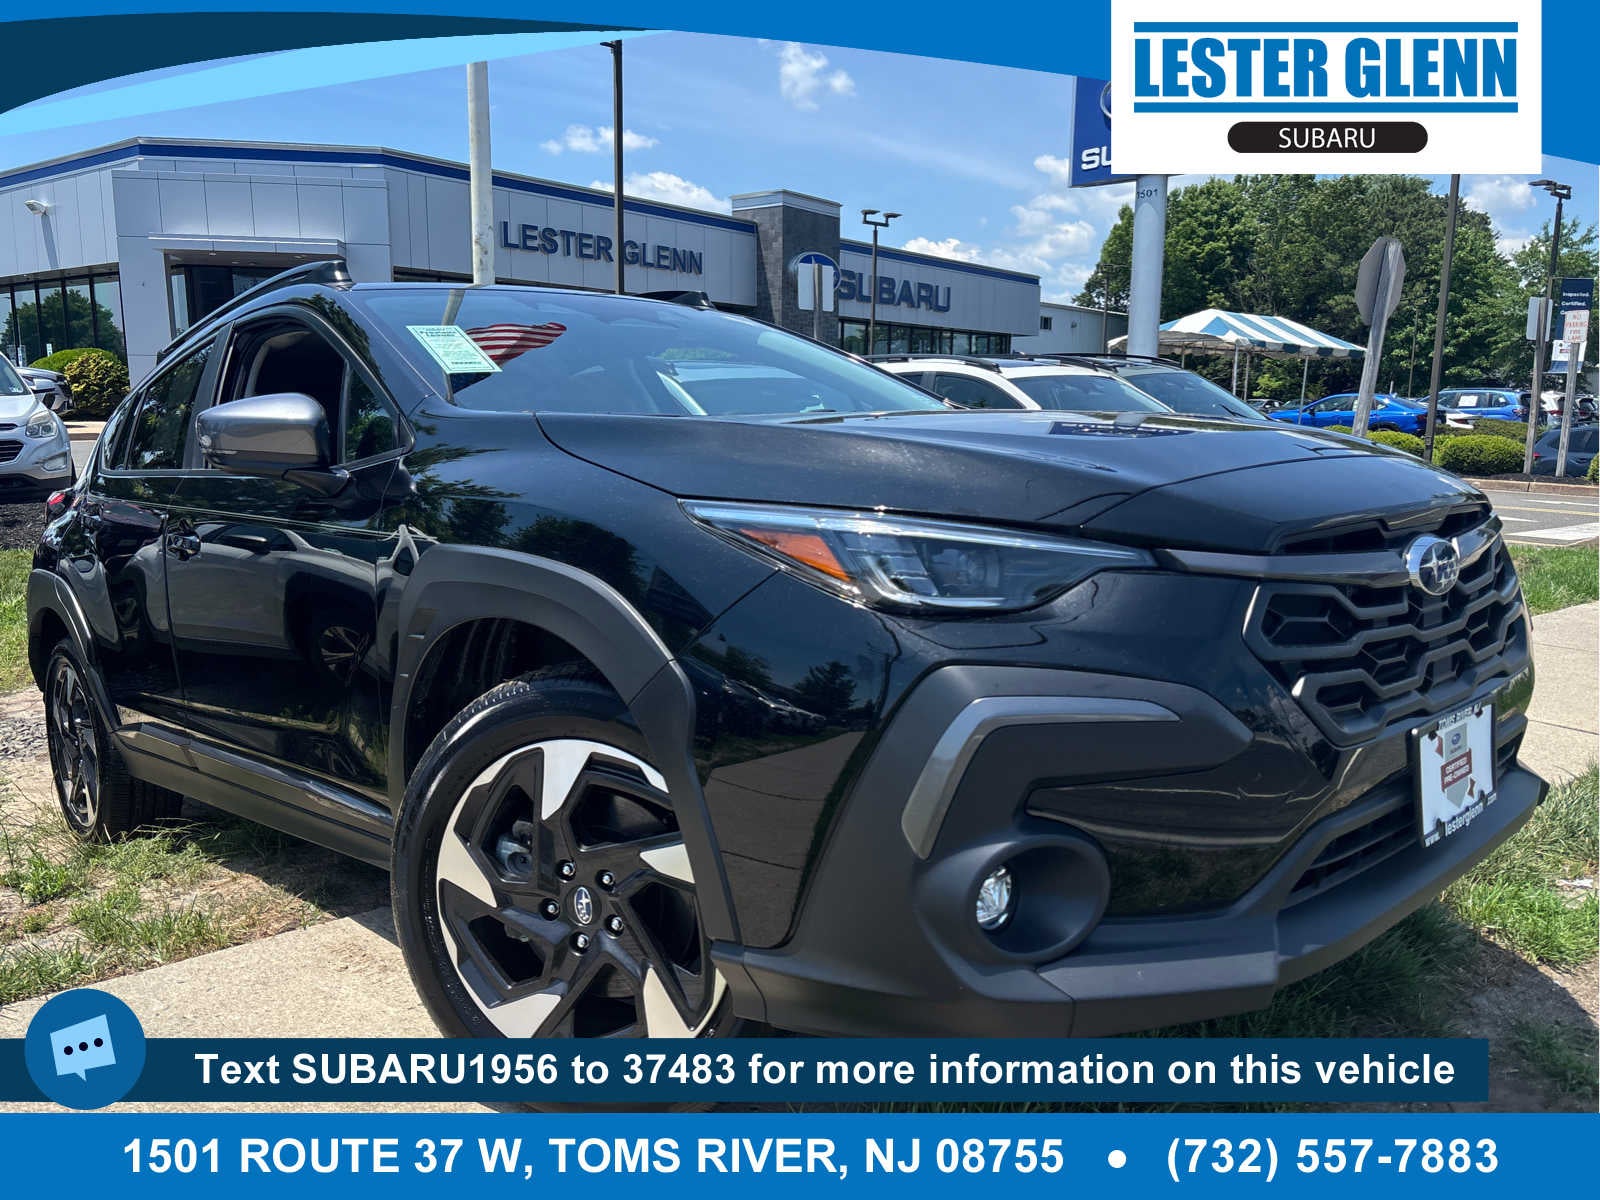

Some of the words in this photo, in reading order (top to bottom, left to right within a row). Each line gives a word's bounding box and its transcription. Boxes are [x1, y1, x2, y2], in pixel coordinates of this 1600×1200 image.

[501, 221, 614, 263] LESTER
[623, 239, 703, 275] GLENN
[838, 268, 952, 313] SUBARU
[1445, 757, 1468, 774] CERTIFIED
